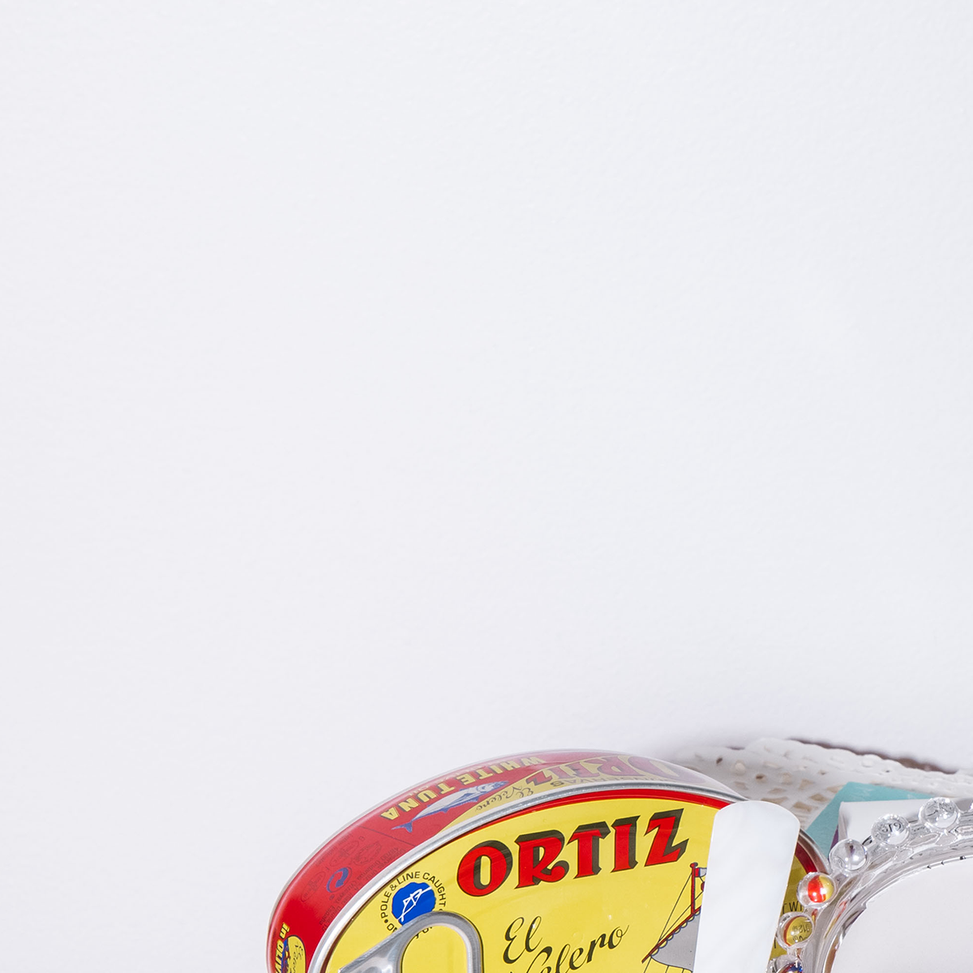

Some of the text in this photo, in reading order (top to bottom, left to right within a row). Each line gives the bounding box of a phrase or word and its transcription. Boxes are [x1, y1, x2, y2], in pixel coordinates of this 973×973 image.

[456, 756, 546, 785] WHITE
[380, 783, 456, 820] TUNA
[457, 808, 689, 897] ORTIZ
[380, 871, 446, 919] POLE & LINE CAUGHT
[503, 915, 542, 964] El
